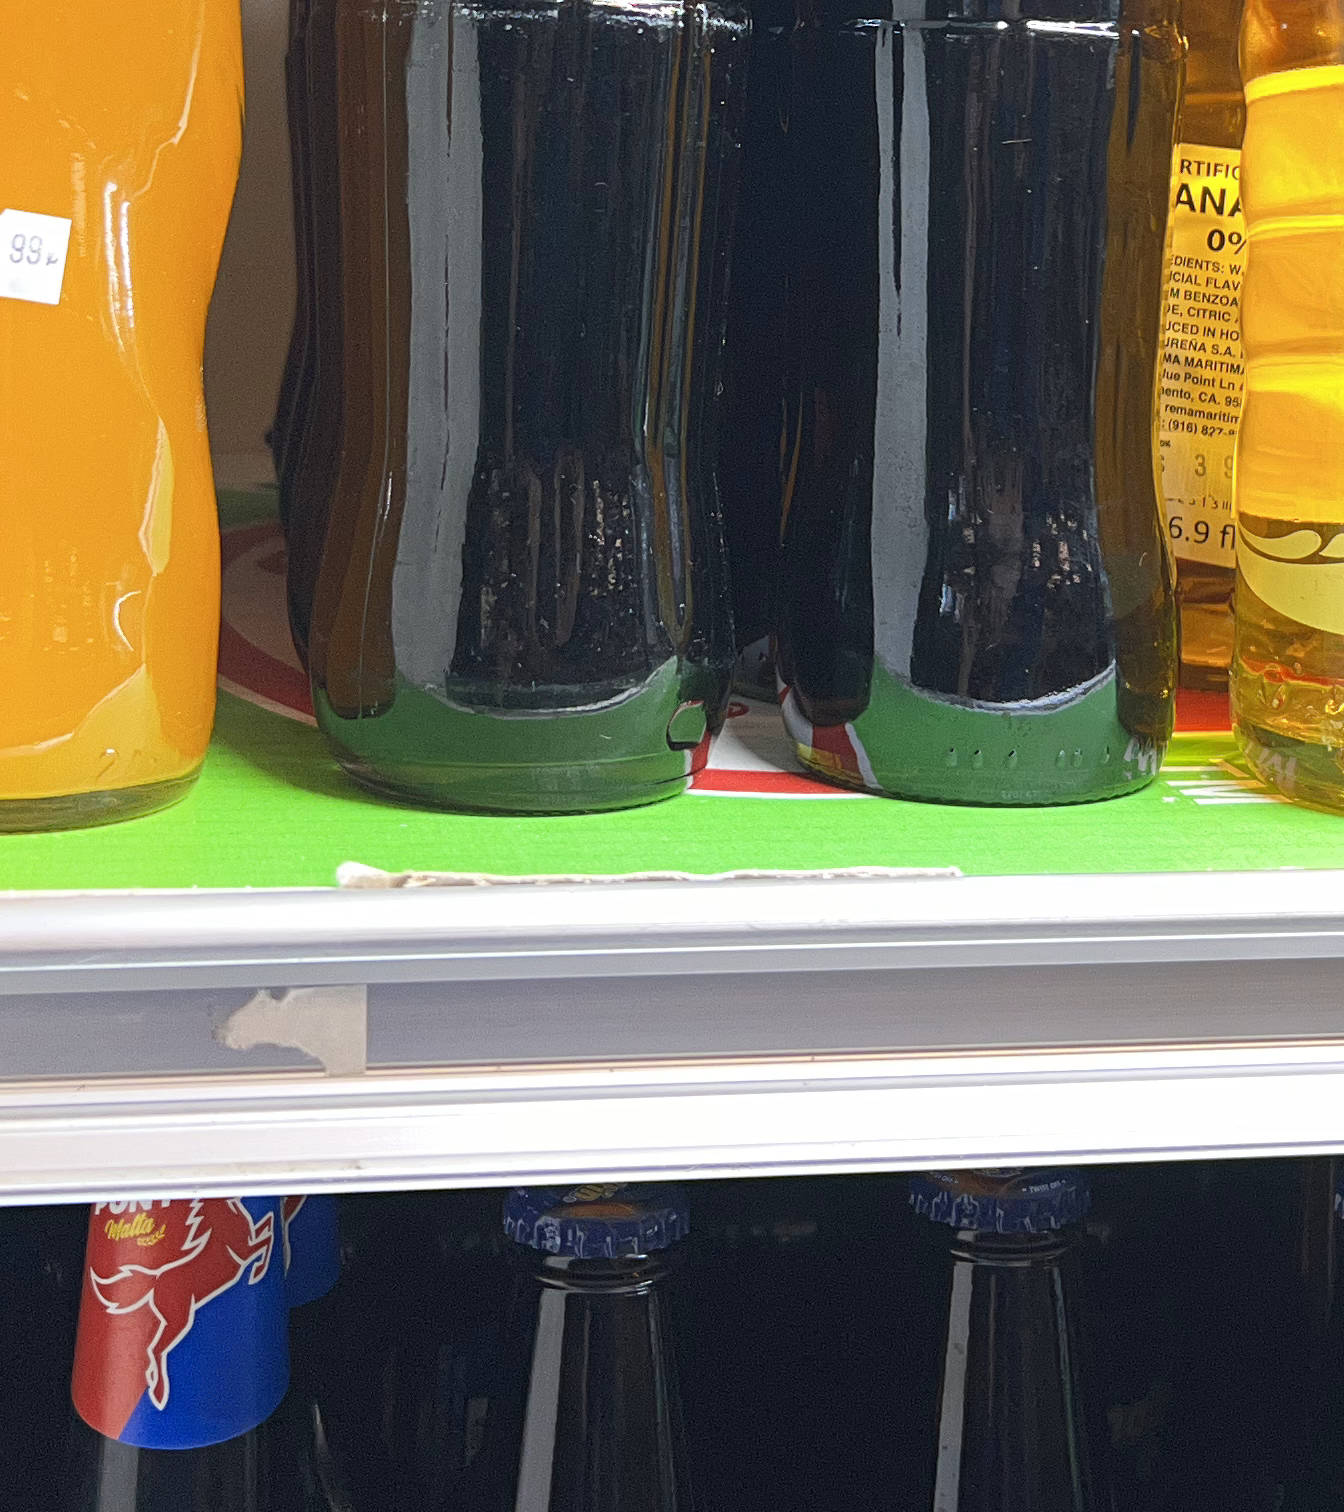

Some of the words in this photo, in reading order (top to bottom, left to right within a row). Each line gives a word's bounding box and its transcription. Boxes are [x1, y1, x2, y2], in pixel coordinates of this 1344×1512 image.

[1180, 158, 1241, 180] RTIFIC
[1206, 276, 1241, 291] FLAV
[1184, 290, 1239, 307] BENZOA
[1187, 306, 1231, 323] CITRIC
[1203, 326, 1216, 338] IN
[1162, 368, 1181, 381] lue
[1184, 372, 1216, 387] Point
[1219, 378, 1235, 391] Ln
[1169, 516, 1210, 545] 6.9
